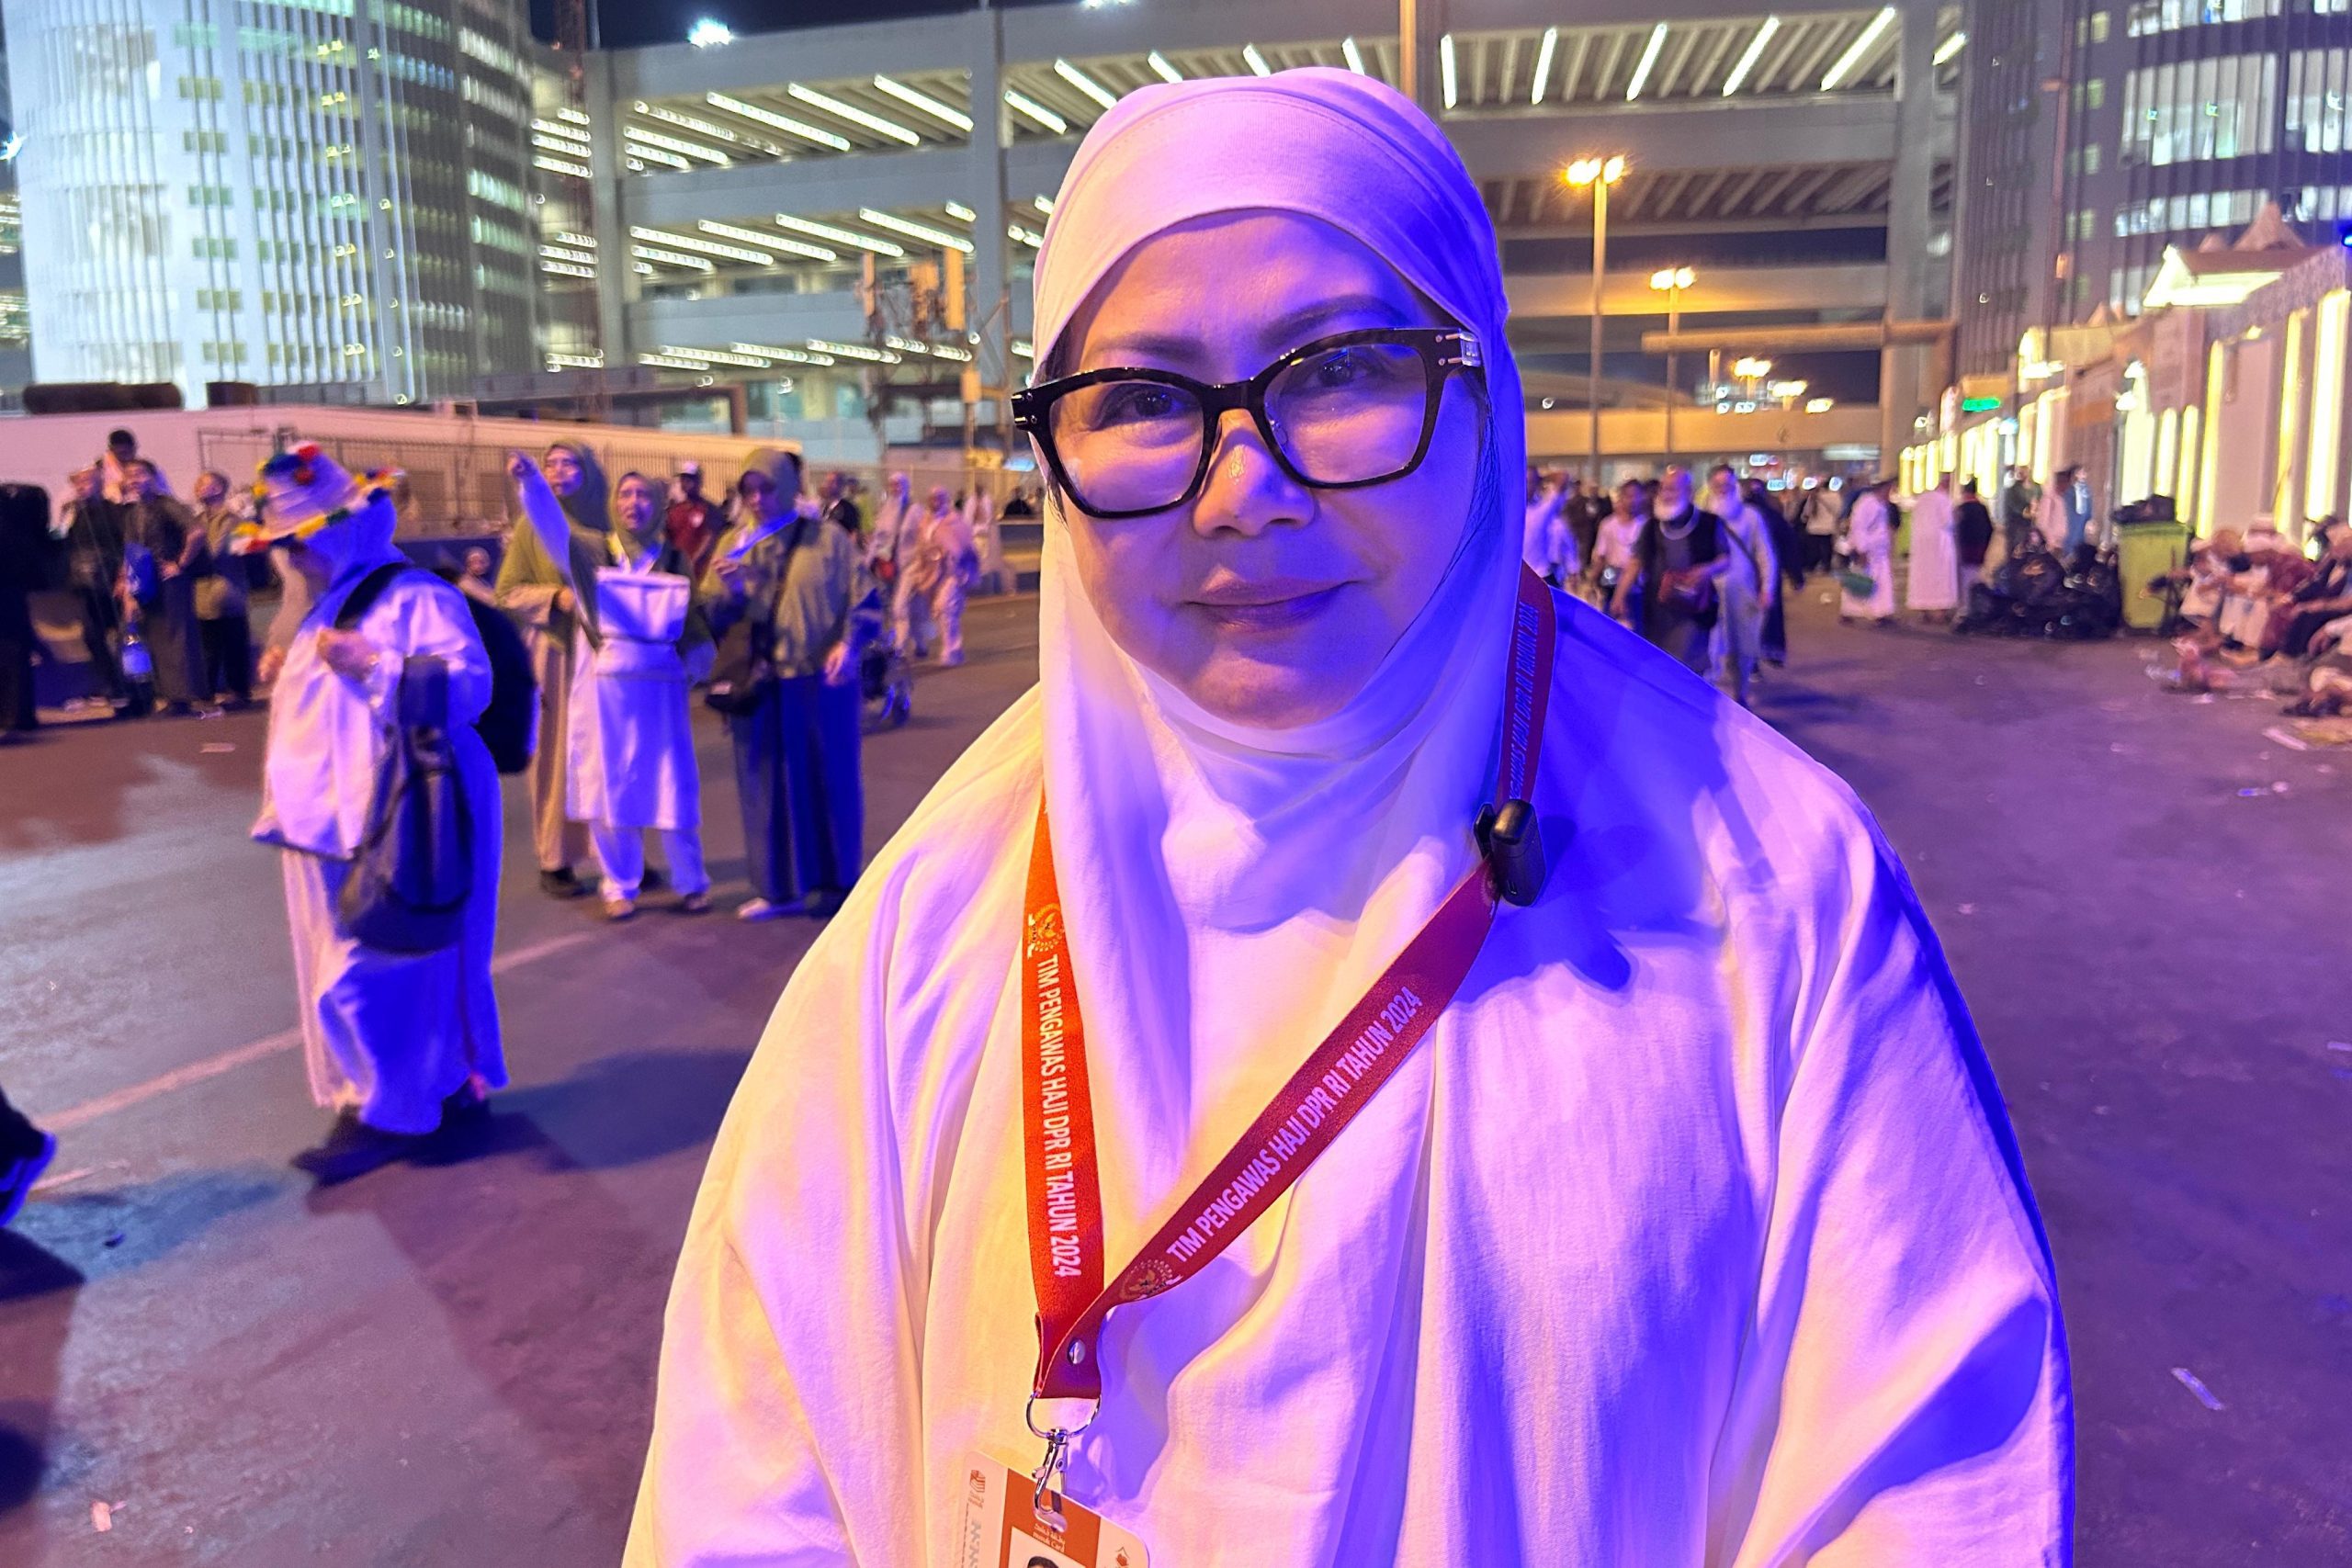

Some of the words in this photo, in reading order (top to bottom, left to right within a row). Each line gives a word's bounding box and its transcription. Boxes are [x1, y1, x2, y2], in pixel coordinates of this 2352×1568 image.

[1518, 602, 1539, 635] 2024
[1515, 629, 1537, 676] TAHUN
[1036, 953, 1060, 989] TIM
[1380, 986, 1423, 1033] 2024
[1038, 987, 1067, 1077] PENGAWAS
[1335, 1020, 1395, 1081] TAHUN
[1042, 1077, 1069, 1115] HAJI
[1322, 1068, 1351, 1099] RI
[1296, 1086, 1338, 1129] DPR
[1043, 1115, 1072, 1152] DPR
[1268, 1114, 1311, 1162] HAJI
[1045, 1152, 1073, 1170] RI
[1046, 1170, 1078, 1232] TAHUN
[1194, 1148, 1282, 1237] PENGAWAS
[1050, 1235, 1082, 1278] 2024
[1165, 1226, 1207, 1262] TIM
